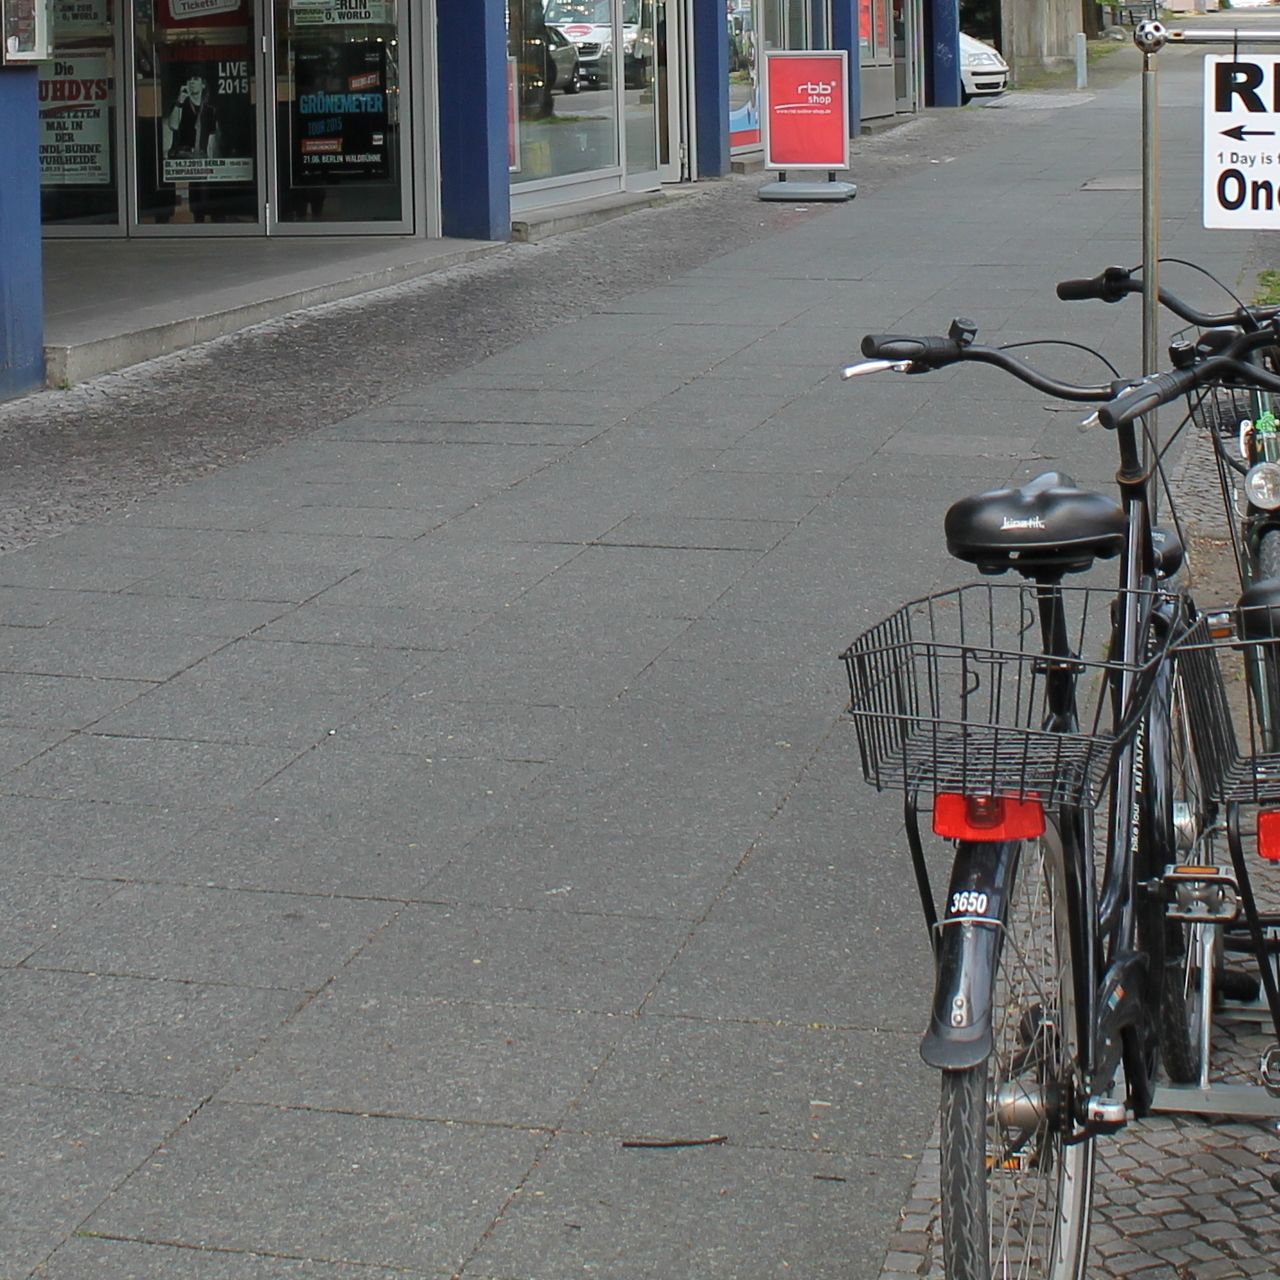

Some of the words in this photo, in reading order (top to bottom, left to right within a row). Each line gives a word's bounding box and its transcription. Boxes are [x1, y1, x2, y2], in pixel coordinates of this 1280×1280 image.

[337, 10, 371, 20] WORLD
[54, 61, 74, 76] Die
[217, 62, 248, 77] LIVE
[217, 79, 249, 95] 2015
[798, 81, 832, 94] rbb
[300, 91, 384, 114] GRÖNEMEYER
[808, 94, 832, 105] shop
[46, 121, 70, 131] MAL
[71, 121, 83, 131] IN
[55, 133, 75, 143] DER
[322, 154, 344, 163] BERLIN
[345, 152, 382, 163] WALDBÜHNE
[1217, 152, 1225, 165] 1
[1229, 152, 1258, 168] Day
[1260, 152, 1273, 166] is
[951, 891, 988, 914] 3650
